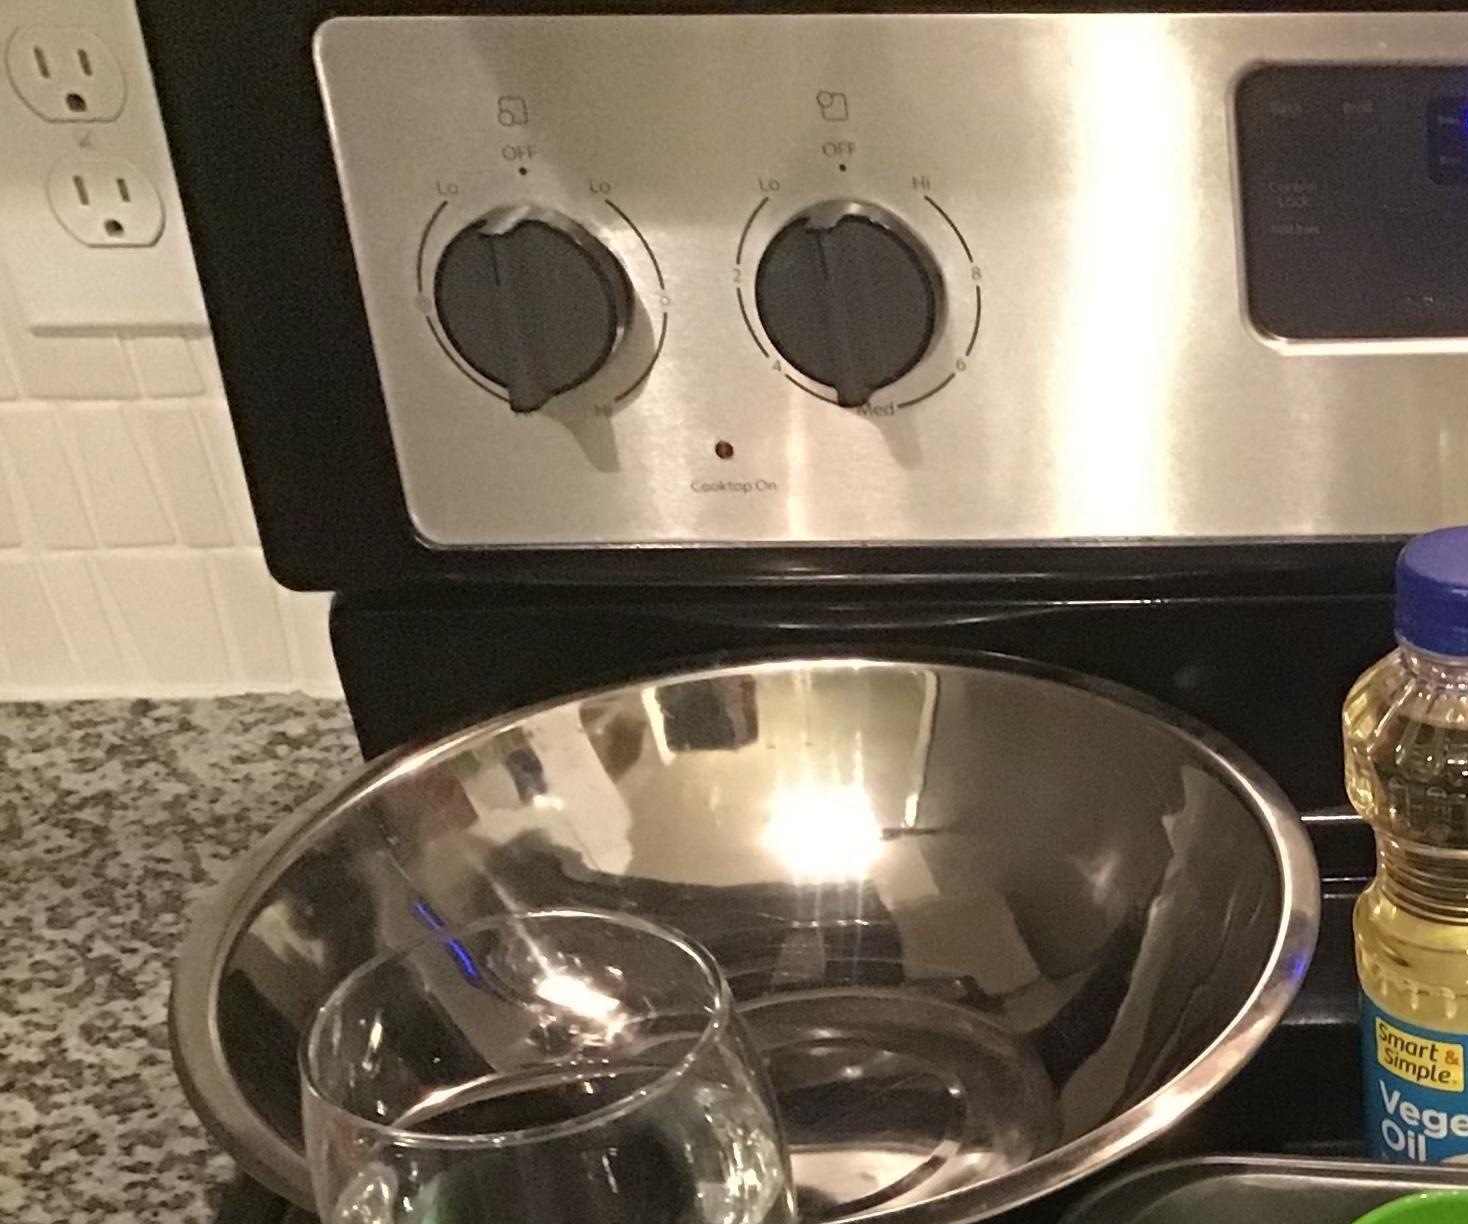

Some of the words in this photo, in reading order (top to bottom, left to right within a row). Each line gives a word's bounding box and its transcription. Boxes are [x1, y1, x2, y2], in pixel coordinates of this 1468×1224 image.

[502, 145, 537, 161] OFF
[822, 141, 857, 158] OFF
[436, 181, 459, 196] Lo
[588, 179, 612, 194] Lo
[758, 178, 780, 193] Lo
[912, 175, 931, 191] Hi
[732, 268, 742, 283] 2
[857, 401, 896, 416] Med
[690, 478, 752, 493] Cooktop
[755, 478, 778, 491] On
[1378, 1022, 1439, 1063] Smart
[1444, 1049, 1460, 1066] &
[1383, 1048, 1452, 1085] Simple
[1381, 1119, 1427, 1163] Oil
